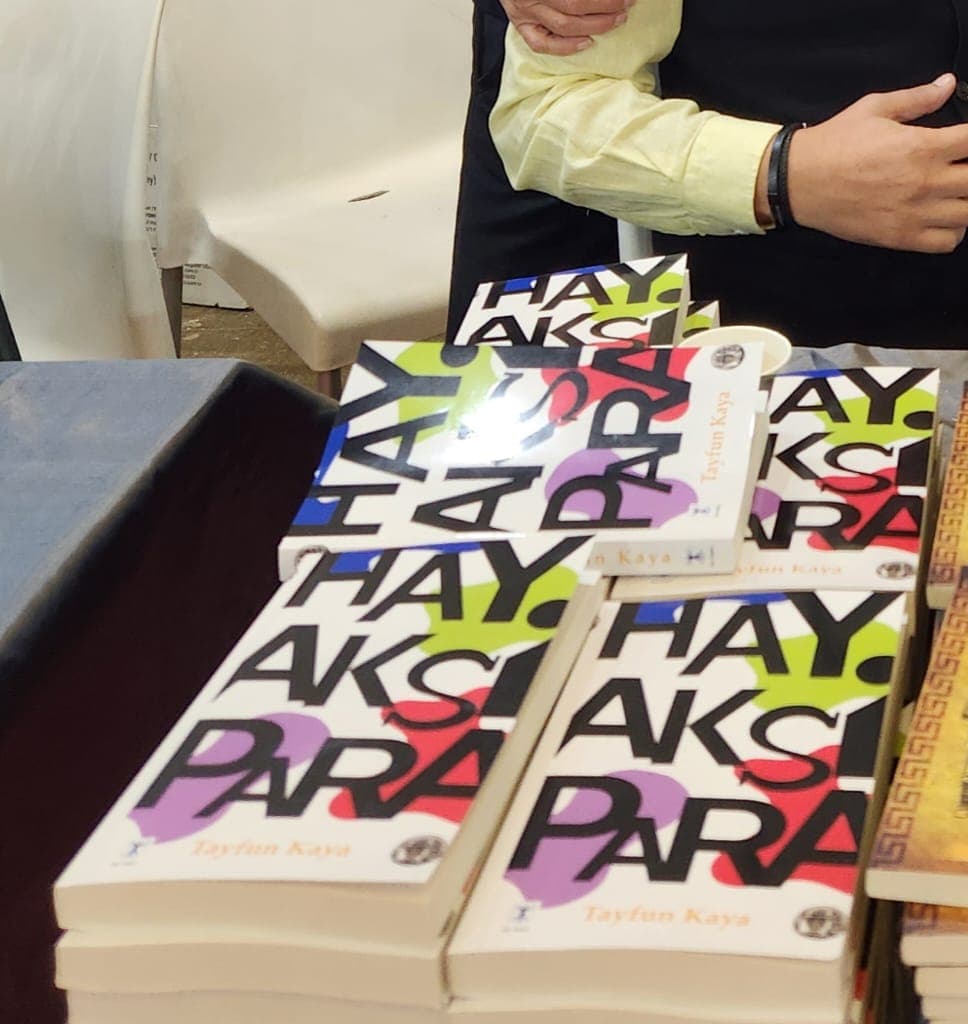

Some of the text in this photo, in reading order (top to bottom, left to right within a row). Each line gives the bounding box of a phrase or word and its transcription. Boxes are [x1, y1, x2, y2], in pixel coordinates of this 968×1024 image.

[708, 391, 733, 430] Kaya
[540, 349, 691, 530] PARA
[744, 494, 924, 550] ARA
[618, 550, 672, 565] Kaya
[137, 719, 507, 820] PARA
[189, 839, 352, 862] Tayfun Kaya
[508, 775, 870, 888] PARA
[583, 905, 750, 929] Tayfun Kaya
